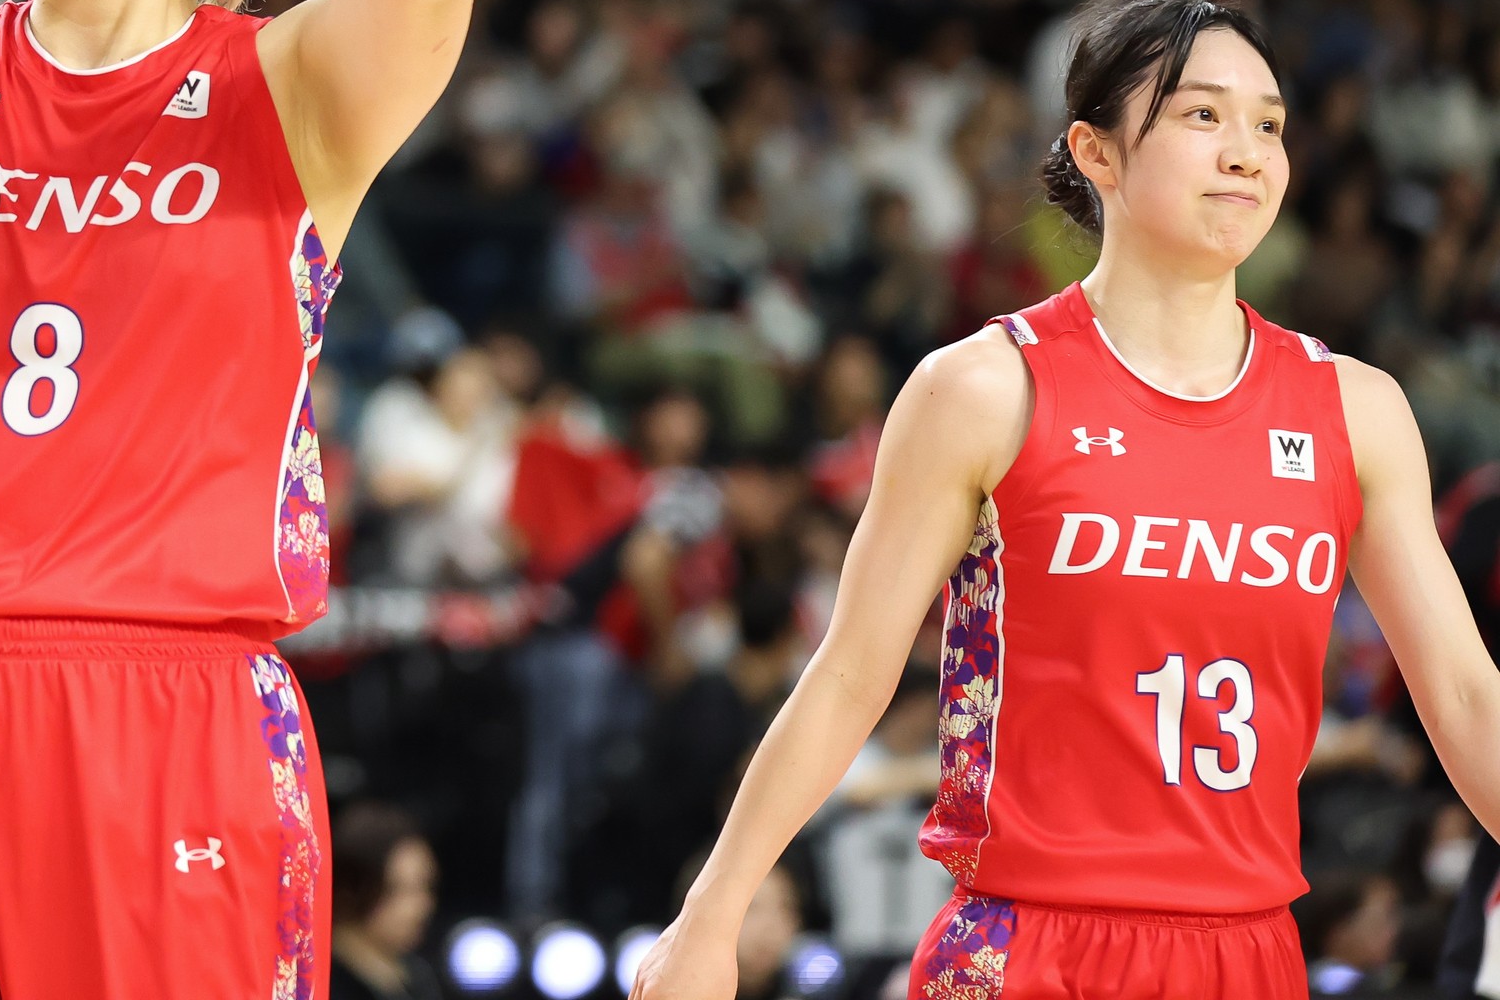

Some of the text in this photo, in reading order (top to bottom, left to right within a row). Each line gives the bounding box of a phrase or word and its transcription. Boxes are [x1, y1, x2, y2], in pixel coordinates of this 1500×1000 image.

[0, 302, 84, 437] 8
[1277, 436, 1305, 459] W
[1047, 513, 1337, 594] DENSO
[1136, 653, 1258, 791] 13
